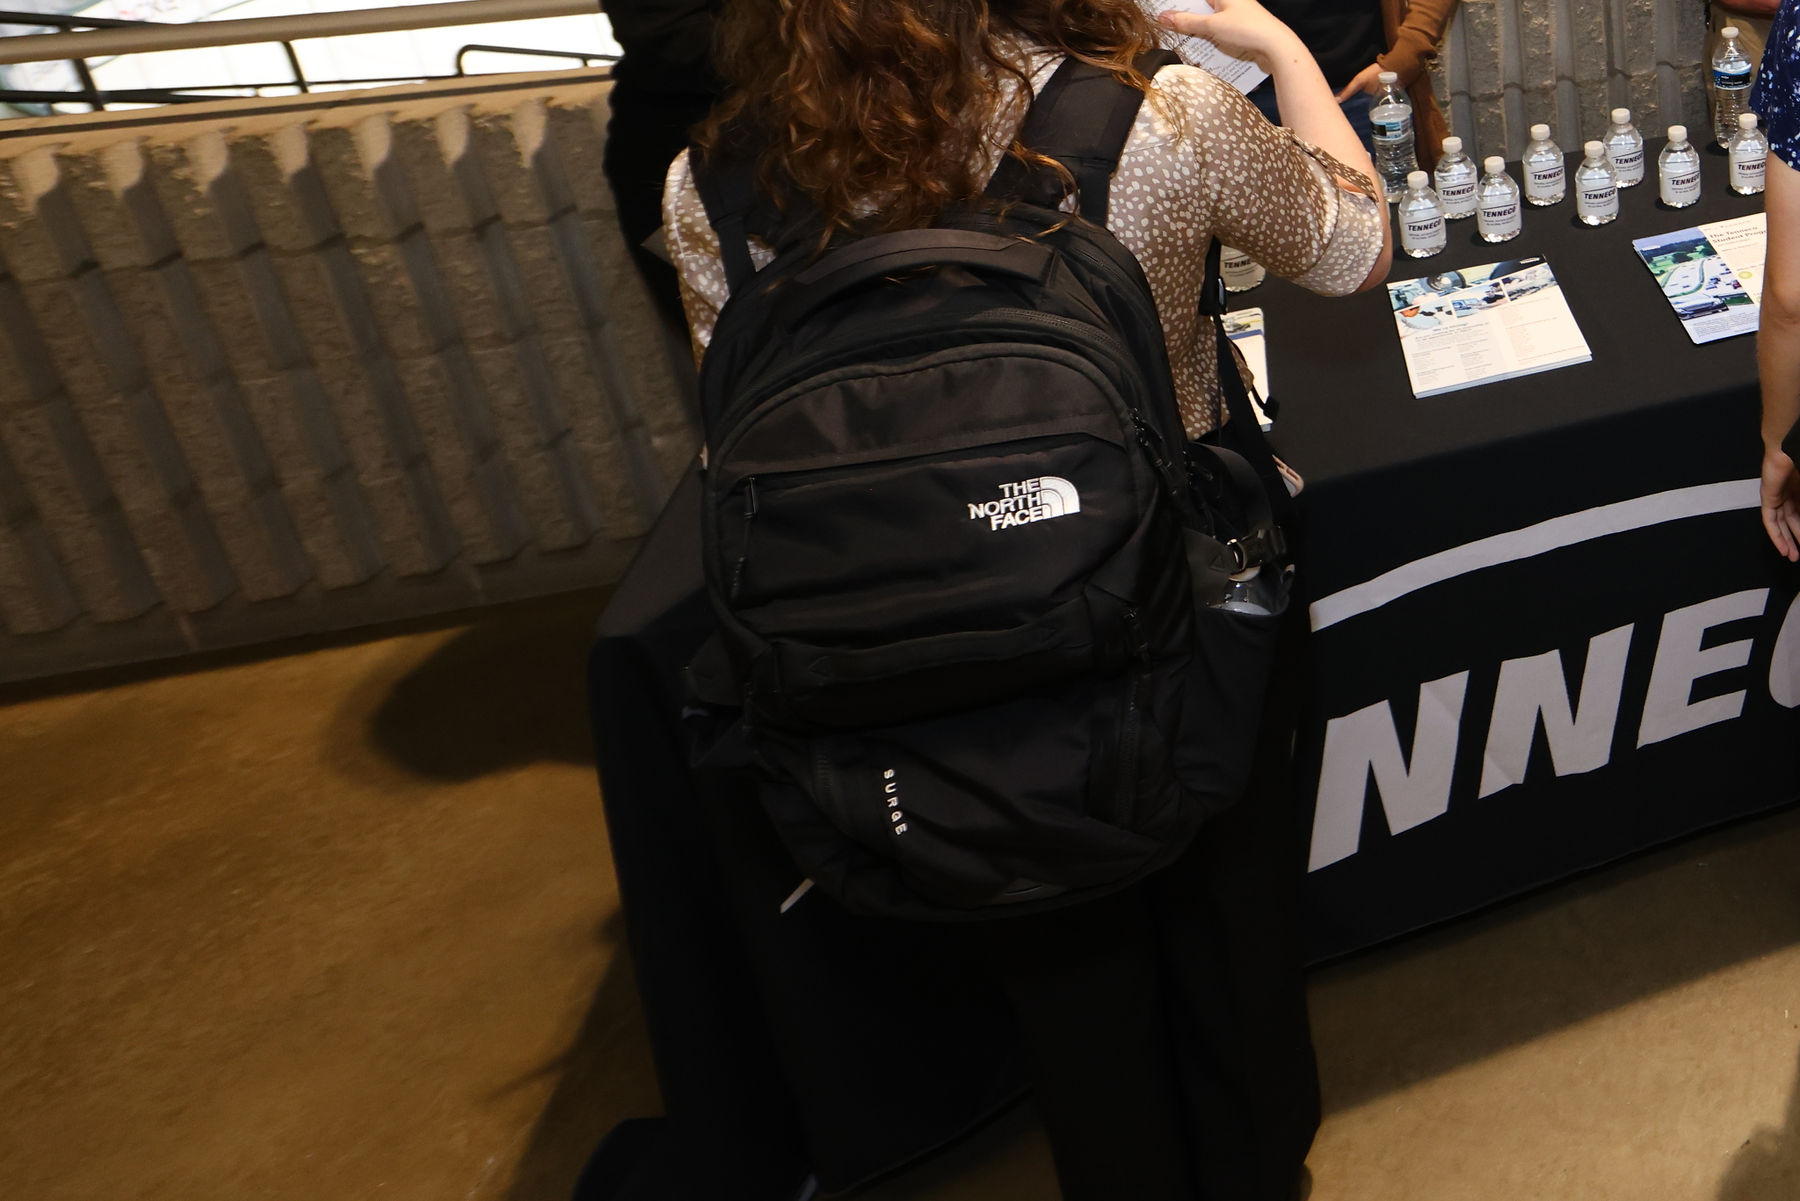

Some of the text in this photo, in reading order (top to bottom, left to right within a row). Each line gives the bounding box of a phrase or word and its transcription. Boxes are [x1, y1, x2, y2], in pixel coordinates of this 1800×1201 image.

[1442, 185, 1475, 197] TENNECO
[1584, 188, 1616, 200] TENNECO
[1483, 206, 1516, 218] TENNECO
[1407, 219, 1441, 232] TENNECO
[998, 478, 1041, 498] THE
[967, 491, 1042, 520] NORTH
[990, 505, 1044, 532] FACE
[883, 768, 908, 836] SURGE
